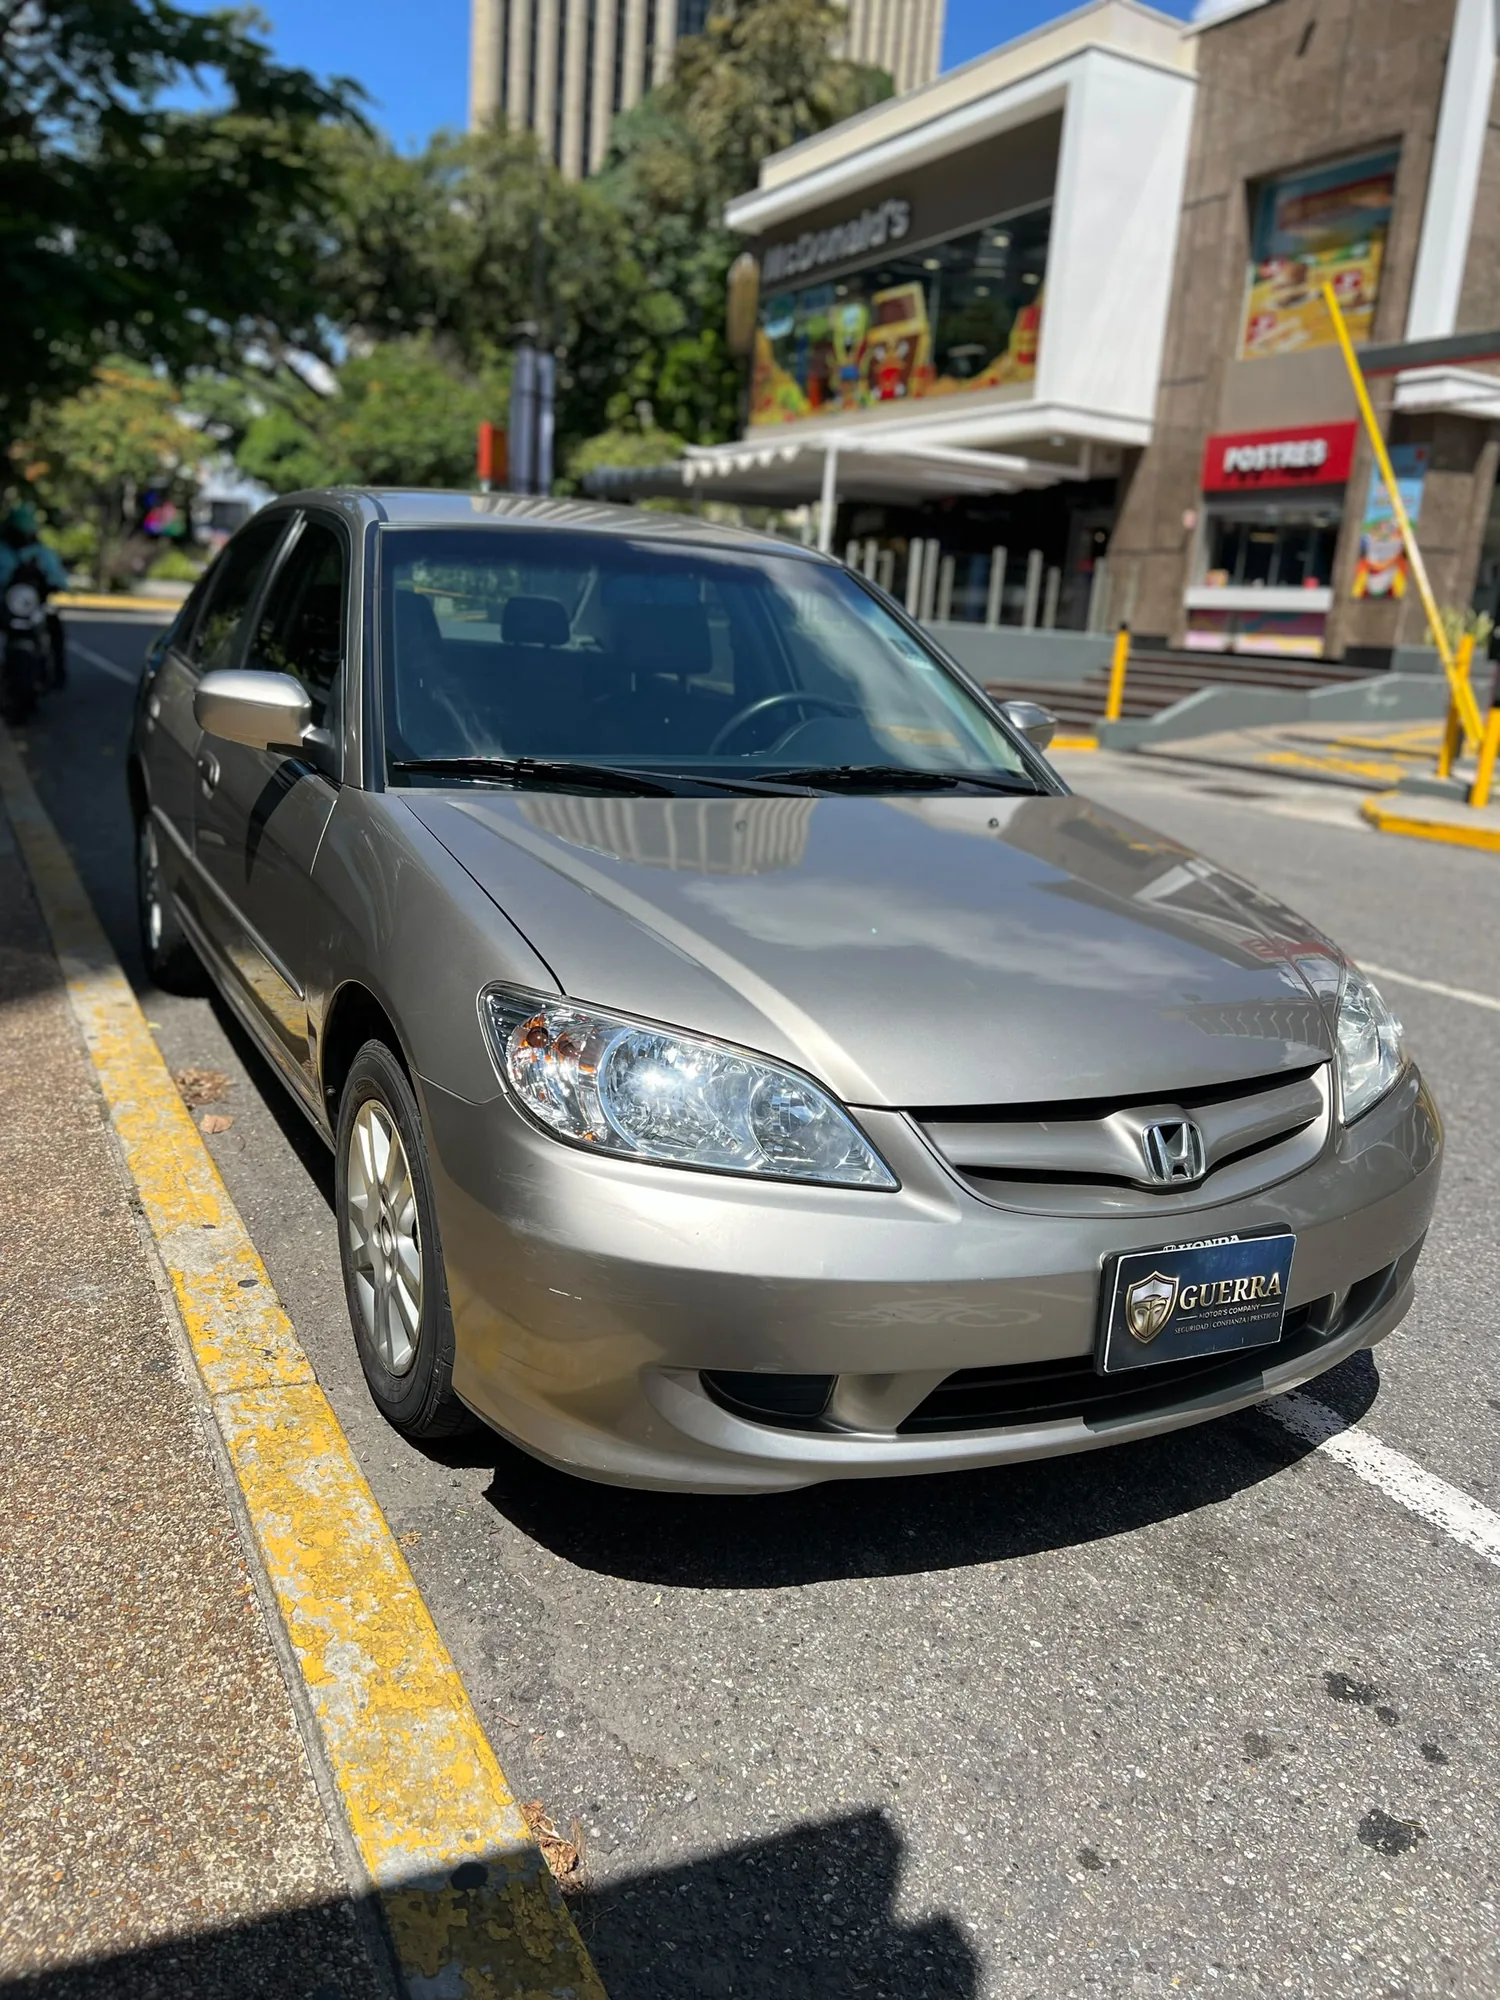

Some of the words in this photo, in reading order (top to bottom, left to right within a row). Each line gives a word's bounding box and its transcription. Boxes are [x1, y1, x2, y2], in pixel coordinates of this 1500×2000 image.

[1223, 438, 1328, 473] POSTRES
[1180, 1272, 1282, 1310] GUERRA
[1228, 1303, 1260, 1315] COMPANY
[1174, 1323, 1209, 1334] SEGURIDAD
[1212, 1316, 1247, 1328] CONFIANZA
